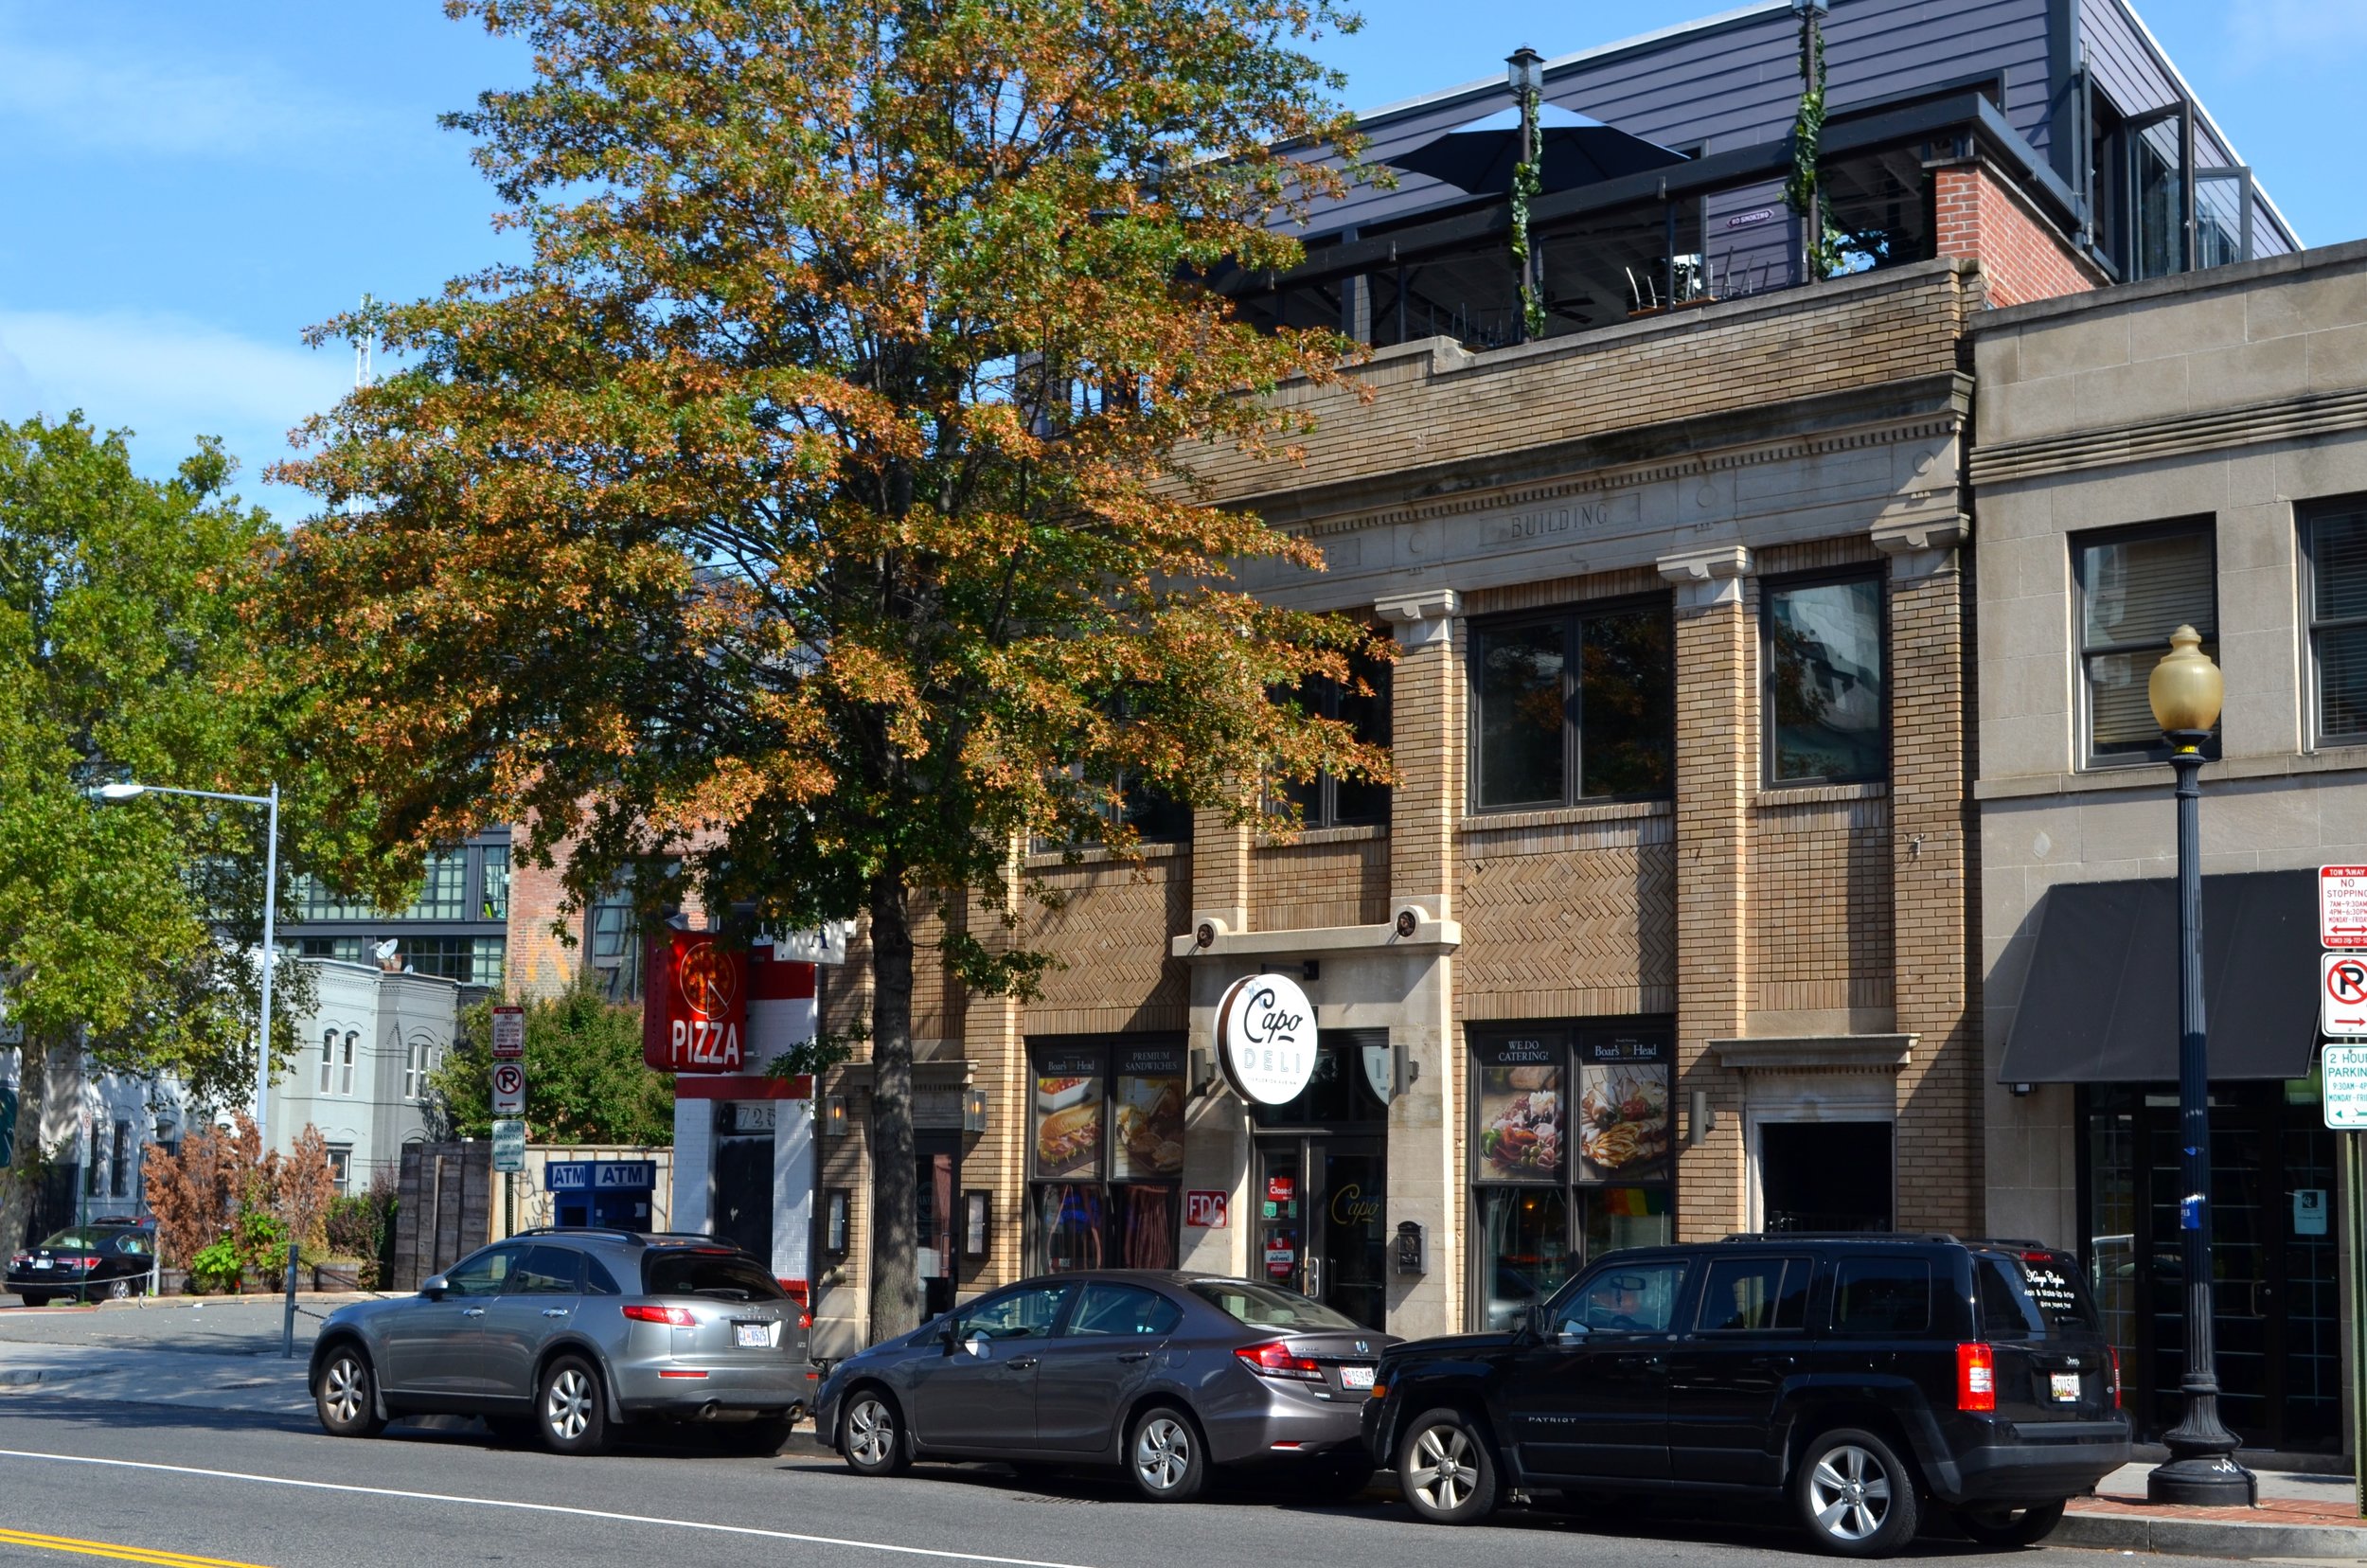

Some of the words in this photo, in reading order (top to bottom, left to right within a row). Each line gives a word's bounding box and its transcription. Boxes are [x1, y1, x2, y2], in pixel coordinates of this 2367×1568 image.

[1511, 503, 1608, 539] BUILDING
[2340, 879, 2355, 887] NO
[1243, 988, 1303, 1043] Capo
[671, 1019, 739, 1066] PIZZA
[1508, 1041, 1523, 1050] WE
[1524, 1041, 1539, 1050] DO
[1132, 1051, 1170, 1060] PREMIUM
[1498, 1051, 1549, 1061] CATERING!
[1594, 1044, 1620, 1057] Boar's
[1633, 1043, 1657, 1056] Head
[1244, 1048, 1301, 1073] DELI
[2329, 1053, 2337, 1063] 2
[1077, 1060, 1095, 1071] Head
[1126, 1061, 1178, 1071] SANDWICHES
[2328, 1067, 2367, 1078] PARKIN
[739, 1107, 776, 1128] 725
[504, 1124, 522, 1132] HOUR
[554, 1167, 585, 1185] ATM
[601, 1166, 643, 1184] ATM
[1270, 1185, 1292, 1195] Closed
[1189, 1195, 1225, 1223] FDC
[1331, 1184, 1379, 1226] Capo
